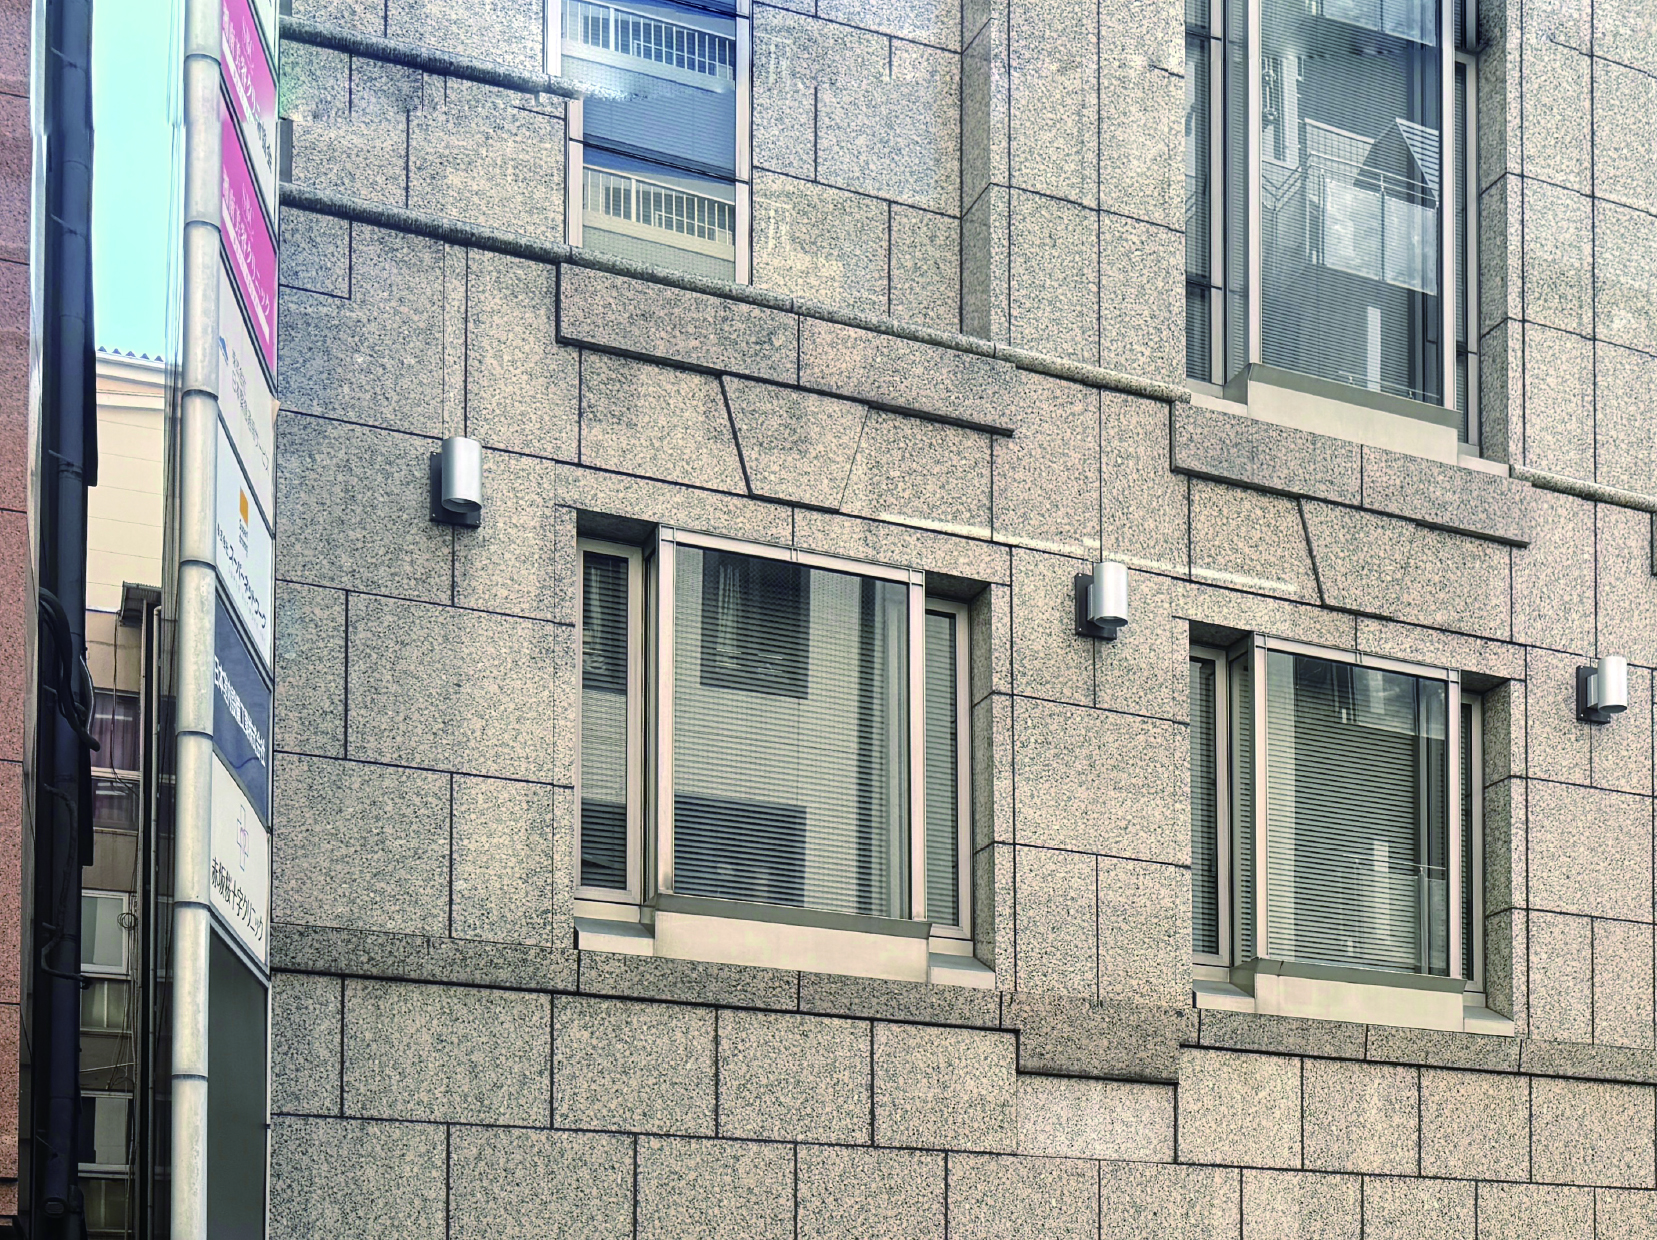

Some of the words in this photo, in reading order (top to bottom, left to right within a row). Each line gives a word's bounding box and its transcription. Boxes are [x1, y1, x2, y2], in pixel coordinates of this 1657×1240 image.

[211, 856, 264, 942] 赤坂桜十字クリニック
